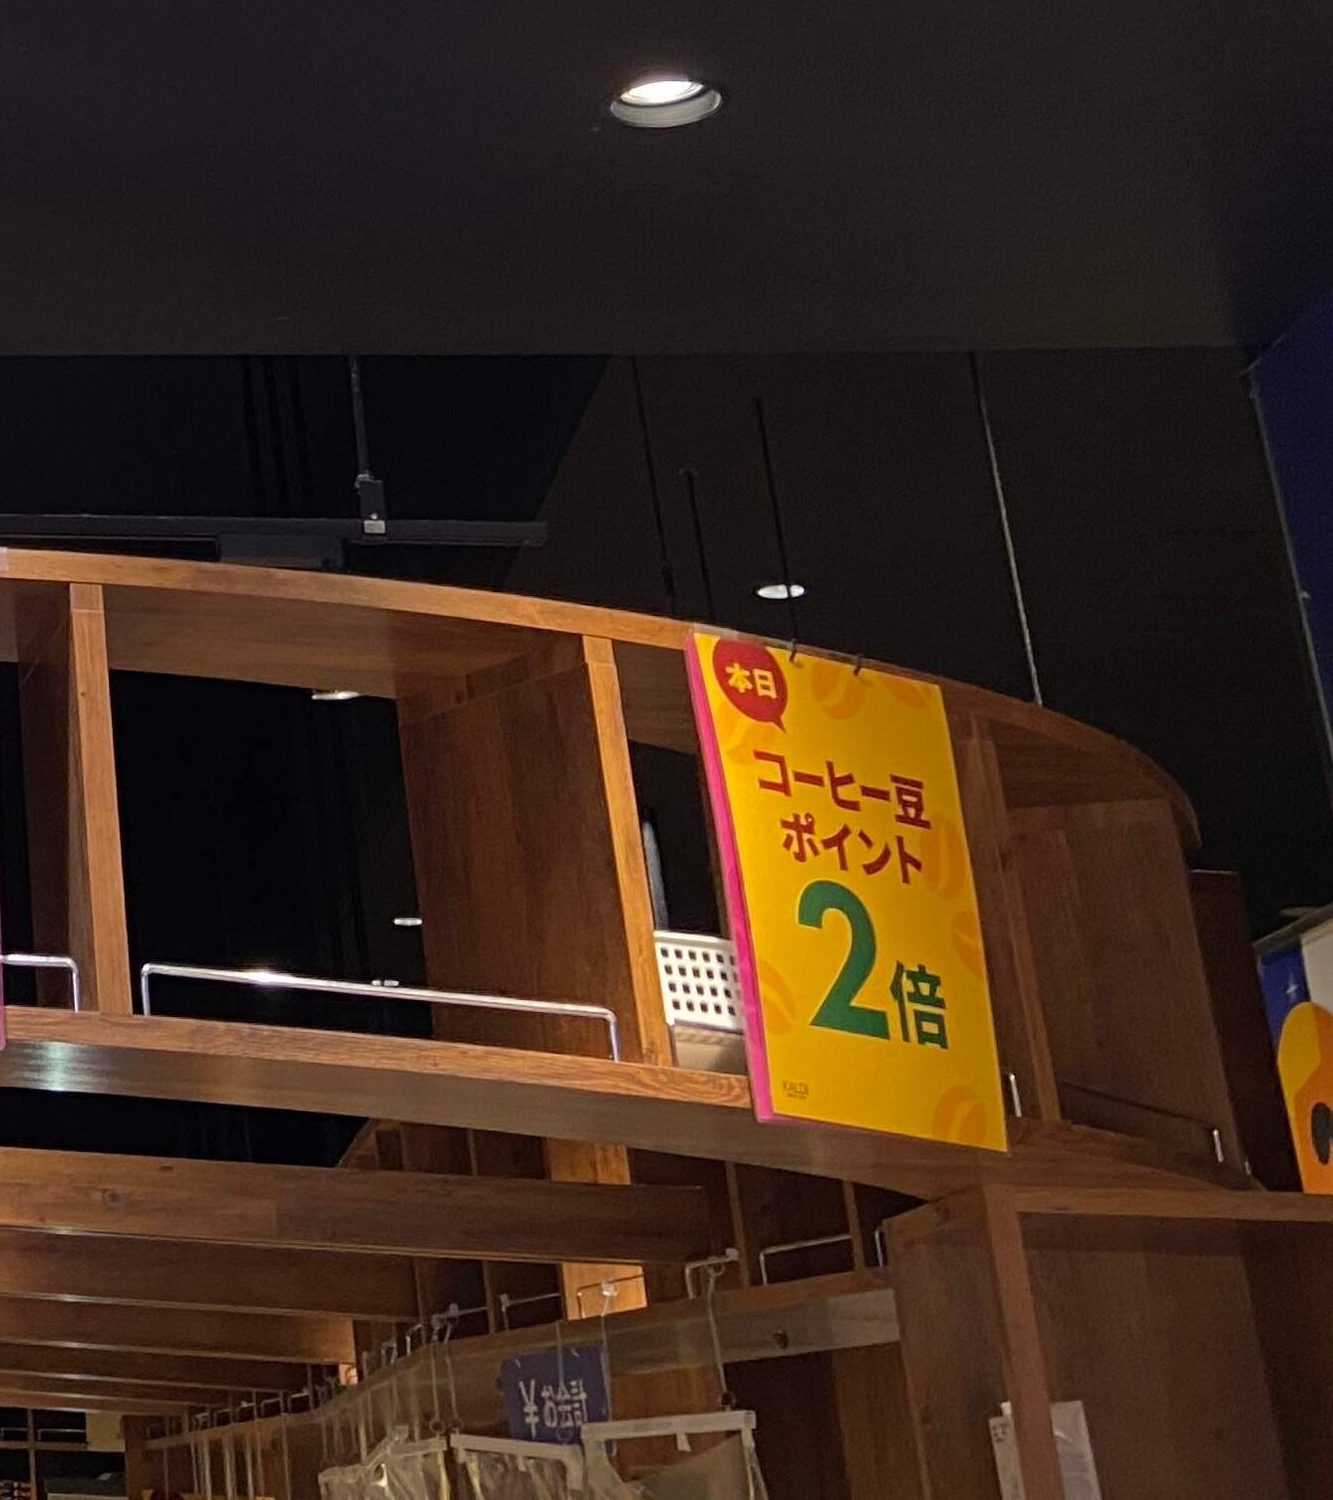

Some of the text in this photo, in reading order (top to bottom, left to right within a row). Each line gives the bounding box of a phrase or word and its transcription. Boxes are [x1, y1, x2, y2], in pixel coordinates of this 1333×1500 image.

[725, 663, 778, 699] 本日
[753, 750, 932, 830] コーヒー豆
[780, 811, 923, 885] ポイント
